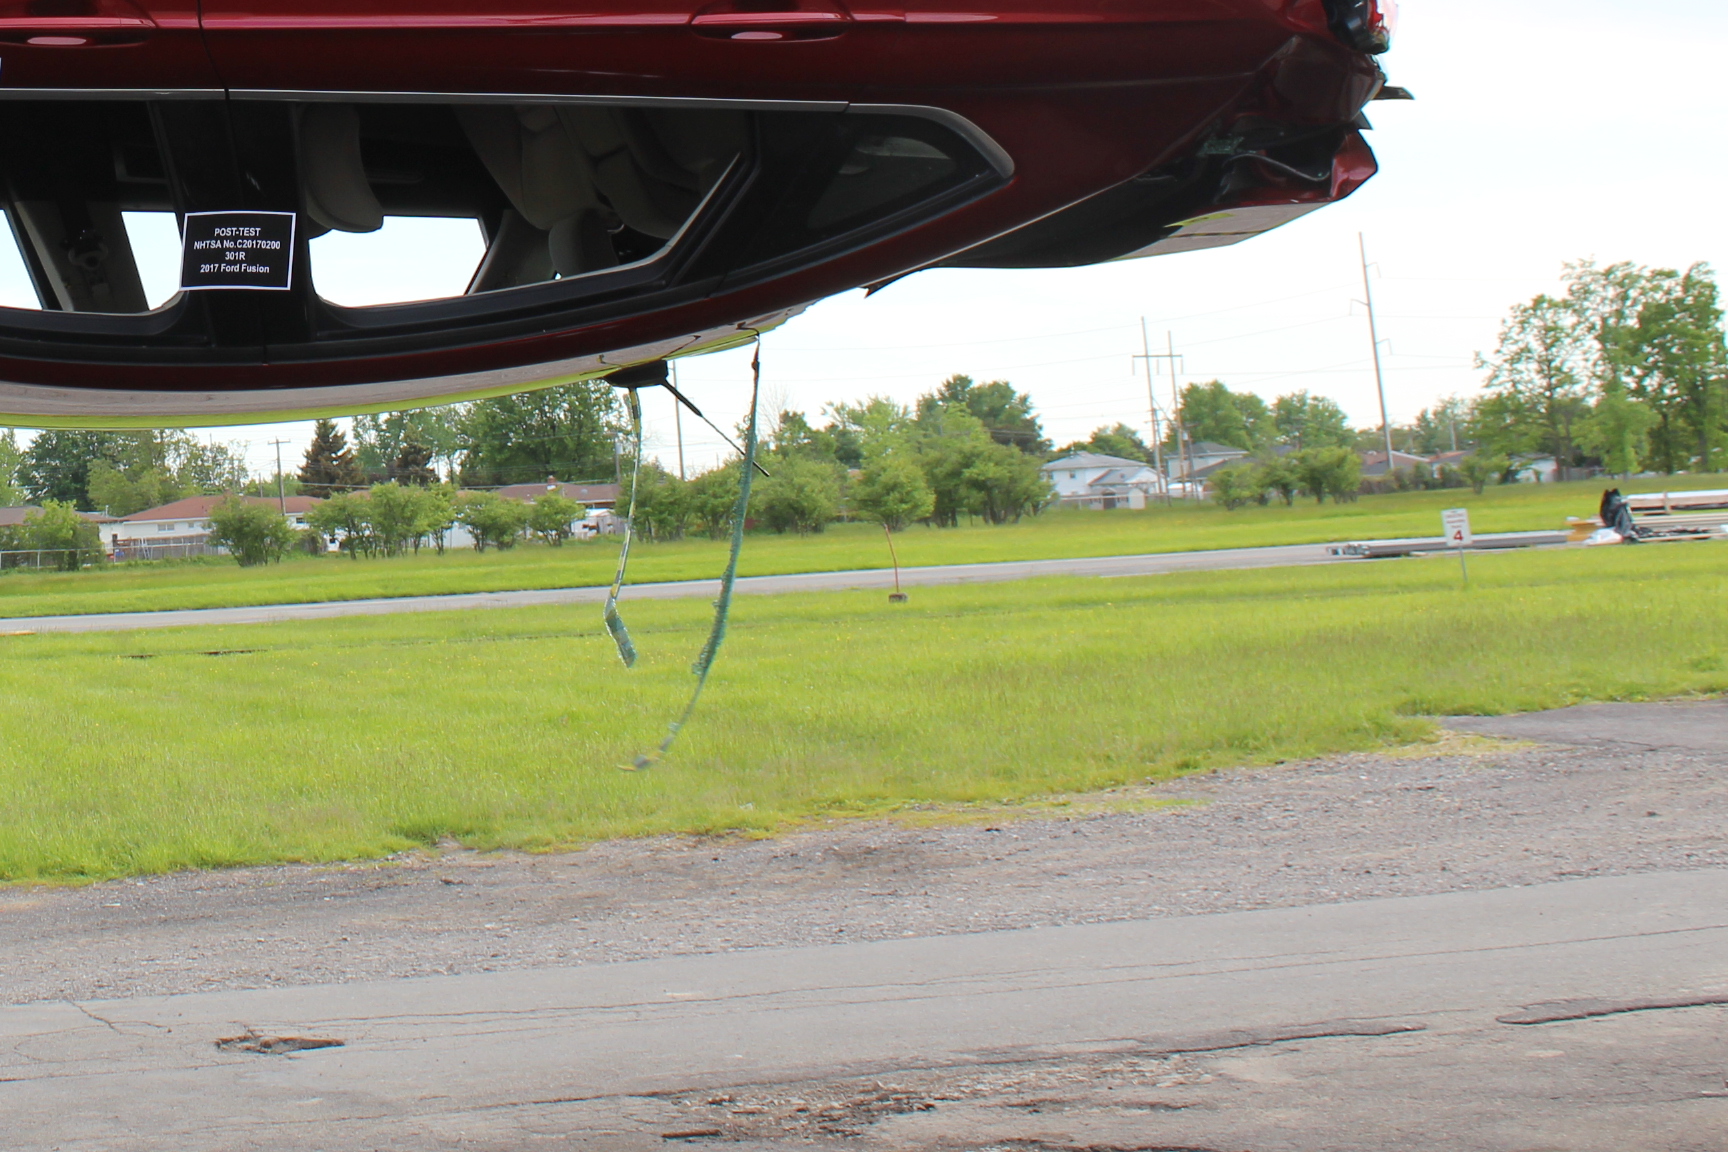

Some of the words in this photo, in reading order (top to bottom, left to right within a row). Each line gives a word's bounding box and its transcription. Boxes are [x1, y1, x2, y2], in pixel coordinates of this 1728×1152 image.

[214, 228, 261, 237] POST-TEST
[194, 240, 221, 250] NHTSA
[225, 251, 246, 260] 301R
[200, 264, 218, 273] 2017
[220, 264, 239, 272] Ford
[241, 264, 270, 273] Fusion
[1453, 530, 1463, 541] 4
